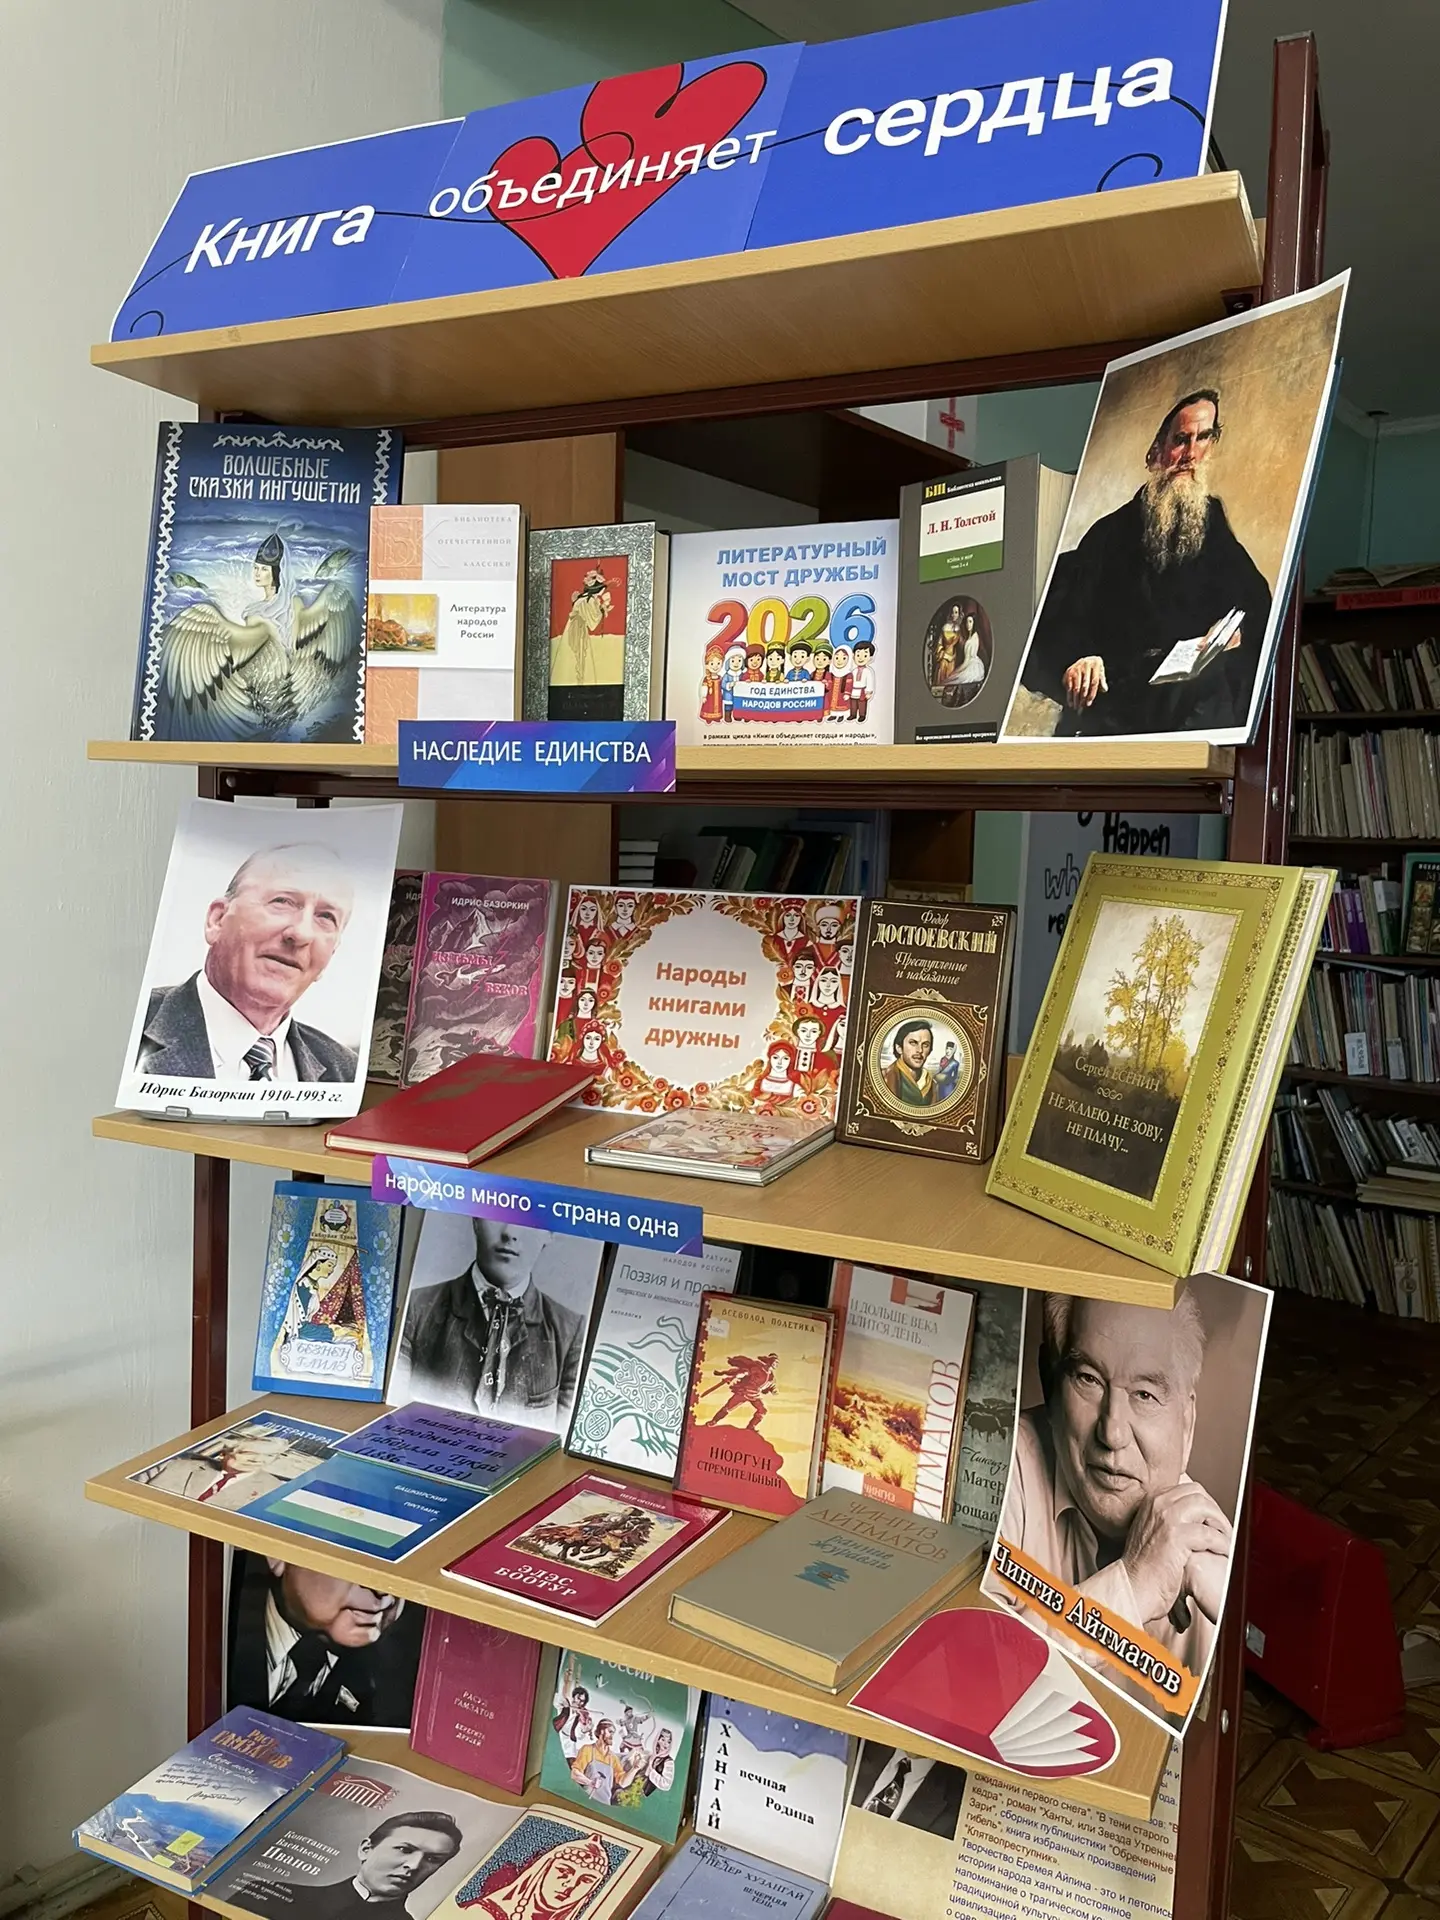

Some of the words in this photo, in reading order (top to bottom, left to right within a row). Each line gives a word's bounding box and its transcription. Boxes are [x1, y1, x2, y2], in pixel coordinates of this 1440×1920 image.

[184, 204, 375, 273] Книга
[428, 127, 777, 218] объединяет
[824, 57, 1173, 156] сердца
[223, 454, 330, 479] ВОЛШЕБНЫЕ
[188, 476, 254, 500] СКАЗКИ
[259, 480, 361, 504] ИНГУШЕТИИ
[927, 523, 938, 535] Л.
[940, 520, 952, 532] Н.
[954, 510, 996, 529] Толстой
[716, 536, 887, 565] ЛИТЕРАТУРНЫЙ
[722, 570, 779, 588] МОСТ
[783, 564, 879, 588] ДРУЖБЫ
[450, 604, 507, 614] Литература
[457, 618, 498, 626] народов
[460, 630, 495, 639] России
[705, 593, 876, 653] 2026
[742, 700, 782, 709] НАРОДОВ
[782, 699, 817, 708] РОССИИ
[750, 686, 767, 696] ГОД
[769, 686, 816, 696] ЕДИНСТВА
[413, 740, 522, 765] НАСЛЕДИЕ
[535, 741, 651, 767] ЕДИНСТВА
[451, 897, 482, 907] ИДРИС
[483, 899, 530, 911] БАЗОРКИН
[920, 910, 949, 929] Федор
[872, 923, 998, 954] ДОСТОЕВСКИЙ
[656, 962, 747, 988] Народы
[893, 951, 968, 973] Преступление
[906, 969, 961, 985] наказание
[648, 996, 746, 1017] книгами
[644, 1028, 740, 1049] дружны
[1075, 1056, 1109, 1077] Сергей
[1112, 1068, 1161, 1092] ЕСЕНИН
[139, 1082, 187, 1098] Идрис
[189, 1085, 255, 1101] Базоркин
[259, 1089, 327, 1102] 1910-1993
[328, 1093, 343, 1102] гг.
[1048, 1092, 1065, 1109] НЕ
[1065, 1099, 1111, 1126] ЖАЛЕЮ,
[1112, 1115, 1131, 1130] НЕ
[1131, 1119, 1164, 1143] ЗОВУ,
[1066, 1121, 1082, 1137] НЕ
[1083, 1127, 1129, 1153] ПЛАЧУ...
[385, 1172, 465, 1200] народов
[471, 1186, 532, 1212] много
[552, 1201, 621, 1228] страна
[627, 1214, 680, 1238] одна
[619, 1264, 667, 1286] Поэзия
[670, 1277, 680, 1289] и
[721, 1308, 766, 1324] ВСЕВОЛОД
[770, 1317, 815, 1333] ПОЛЕТИКА
[847, 1313, 890, 1335] ДЛИТСЯ
[850, 1298, 859, 1311] И
[859, 1302, 908, 1325] ДОЛЬШЕ
[910, 1315, 938, 1334] ВЕКА
[382, 1424, 463, 1447] народный
[414, 1417, 511, 1444] татарский
[709, 1446, 772, 1472] НЮРГУН
[696, 1460, 782, 1489] СТРЕМИТЕЛЬНЫЙ
[963, 1469, 1005, 1496] Матер
[811, 1508, 949, 1560] АЙТМАТОВ
[850, 1501, 938, 1540] ЧИНГИЗ
[493, 1567, 578, 1597] БООТУР
[517, 1564, 574, 1587] ЭЛЭС
[993, 1541, 1065, 1614] Чингиз
[1065, 1598, 1182, 1695] Айтматов
[765, 1796, 815, 1825] Родина
[974, 1773, 1020, 1794] ожидании
[1021, 1788, 1059, 1807] первого
[1109, 1817, 1131, 1830] тени
[1133, 1826, 1170, 1845] старого
[1006, 1797, 1037, 1814] роман
[1077, 1822, 1096, 1834] или
[1098, 1826, 1132, 1846] Звезда
[284, 1830, 340, 1856] Константин
[1000, 1809, 1039, 1828] сборник
[1040, 1823, 1106, 1851] публицистики
[261, 1845, 321, 1876] Иванов
[275, 1838, 331, 1864] Васильевич
[1005, 1825, 1031, 1840] книга
[1033, 1836, 1085, 1859] избранных
[1087, 1854, 1156, 1883] произведений
[962, 1837, 1014, 1864] Творчество
[1016, 1857, 1053, 1877] Еремея
[1055, 1871, 1091, 1890] Айпина
[1100, 1887, 1117, 1899] это
[1119, 1894, 1125, 1902] и
[744, 1872, 804, 1901] ХУЗАНГАЙ
[952, 1880, 1019, 1910] традиционной
[955, 1866, 1018, 1895] напоминание
[1029, 1892, 1089, 1919] трагическом
[958, 1853, 996, 1872] истории
[998, 1866, 1032, 1885] народа
[1034, 1878, 1063, 1896] ханты
[1065, 1891, 1072, 1899] и
[1074, 1894, 1131, 1919] постоянное
